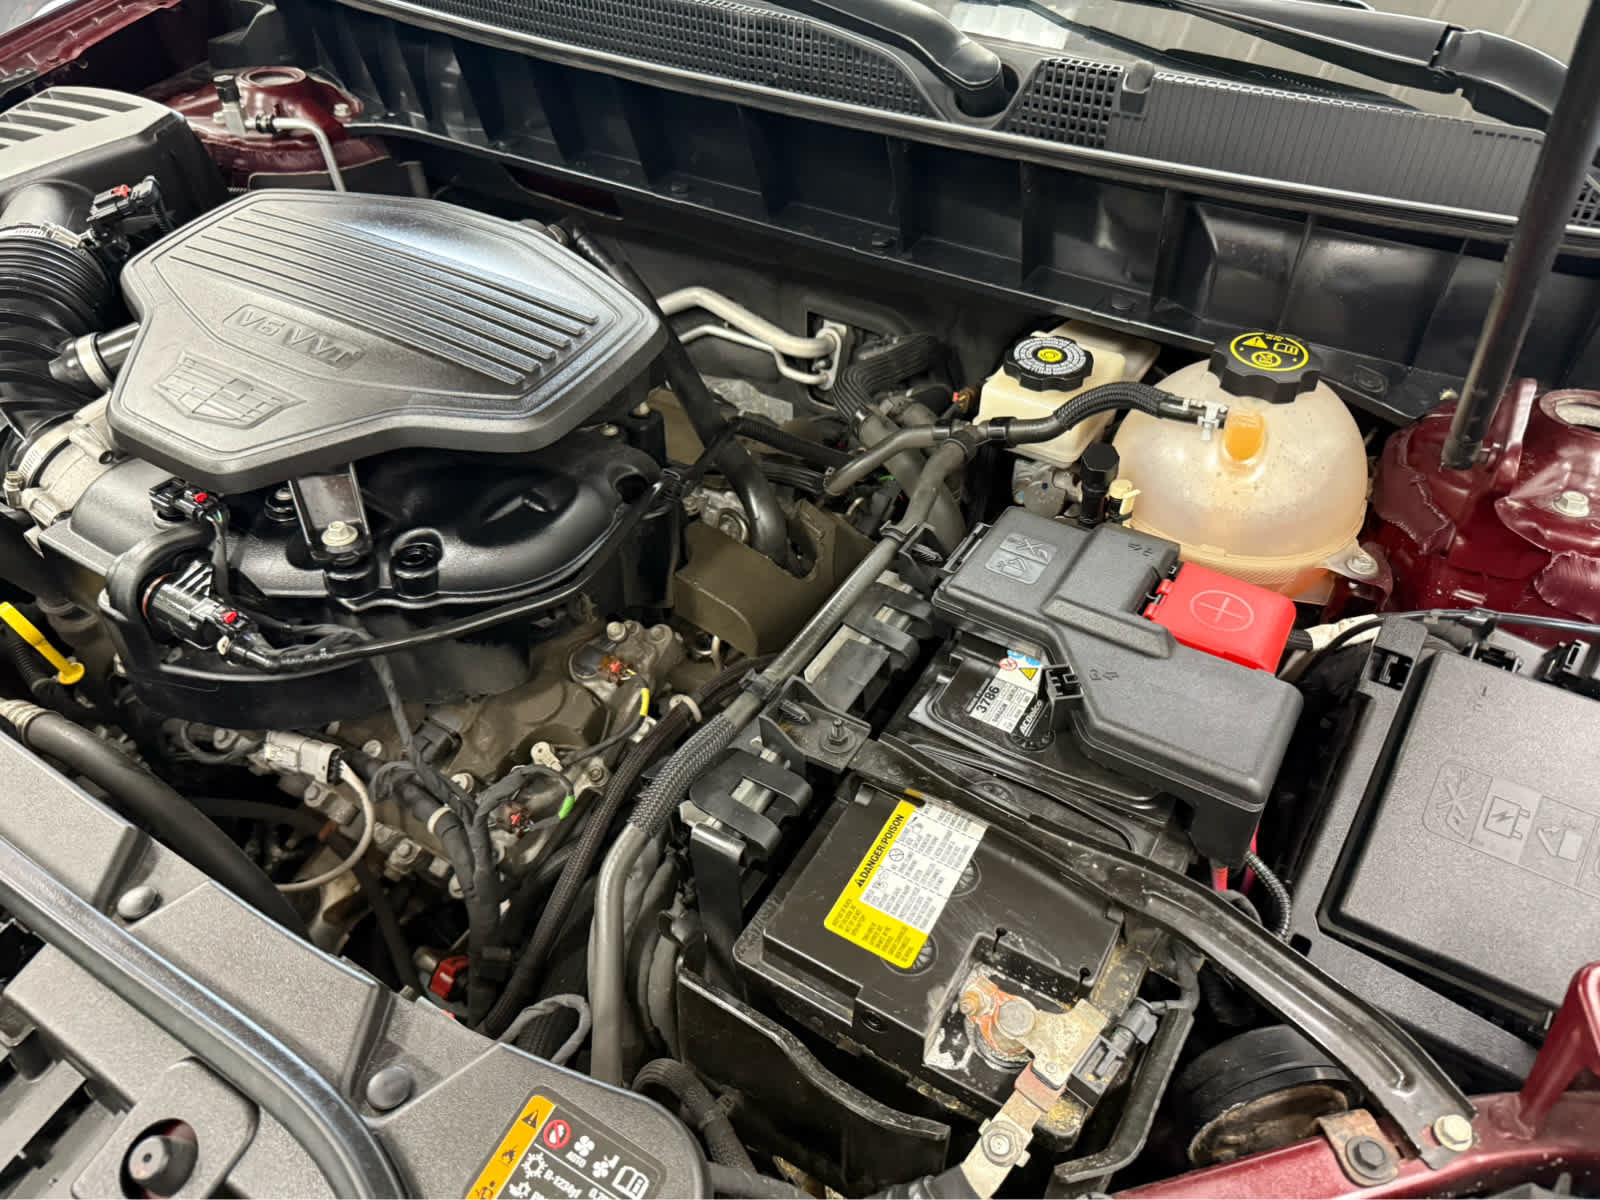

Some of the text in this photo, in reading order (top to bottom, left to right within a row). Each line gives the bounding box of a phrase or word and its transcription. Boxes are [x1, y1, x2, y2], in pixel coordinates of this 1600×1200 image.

[239, 311, 365, 363] V6 VVT
[976, 686, 1000, 713] 3786
[859, 814, 905, 880] DANGER/POISON
[565, 1150, 587, 1168] AUTO
